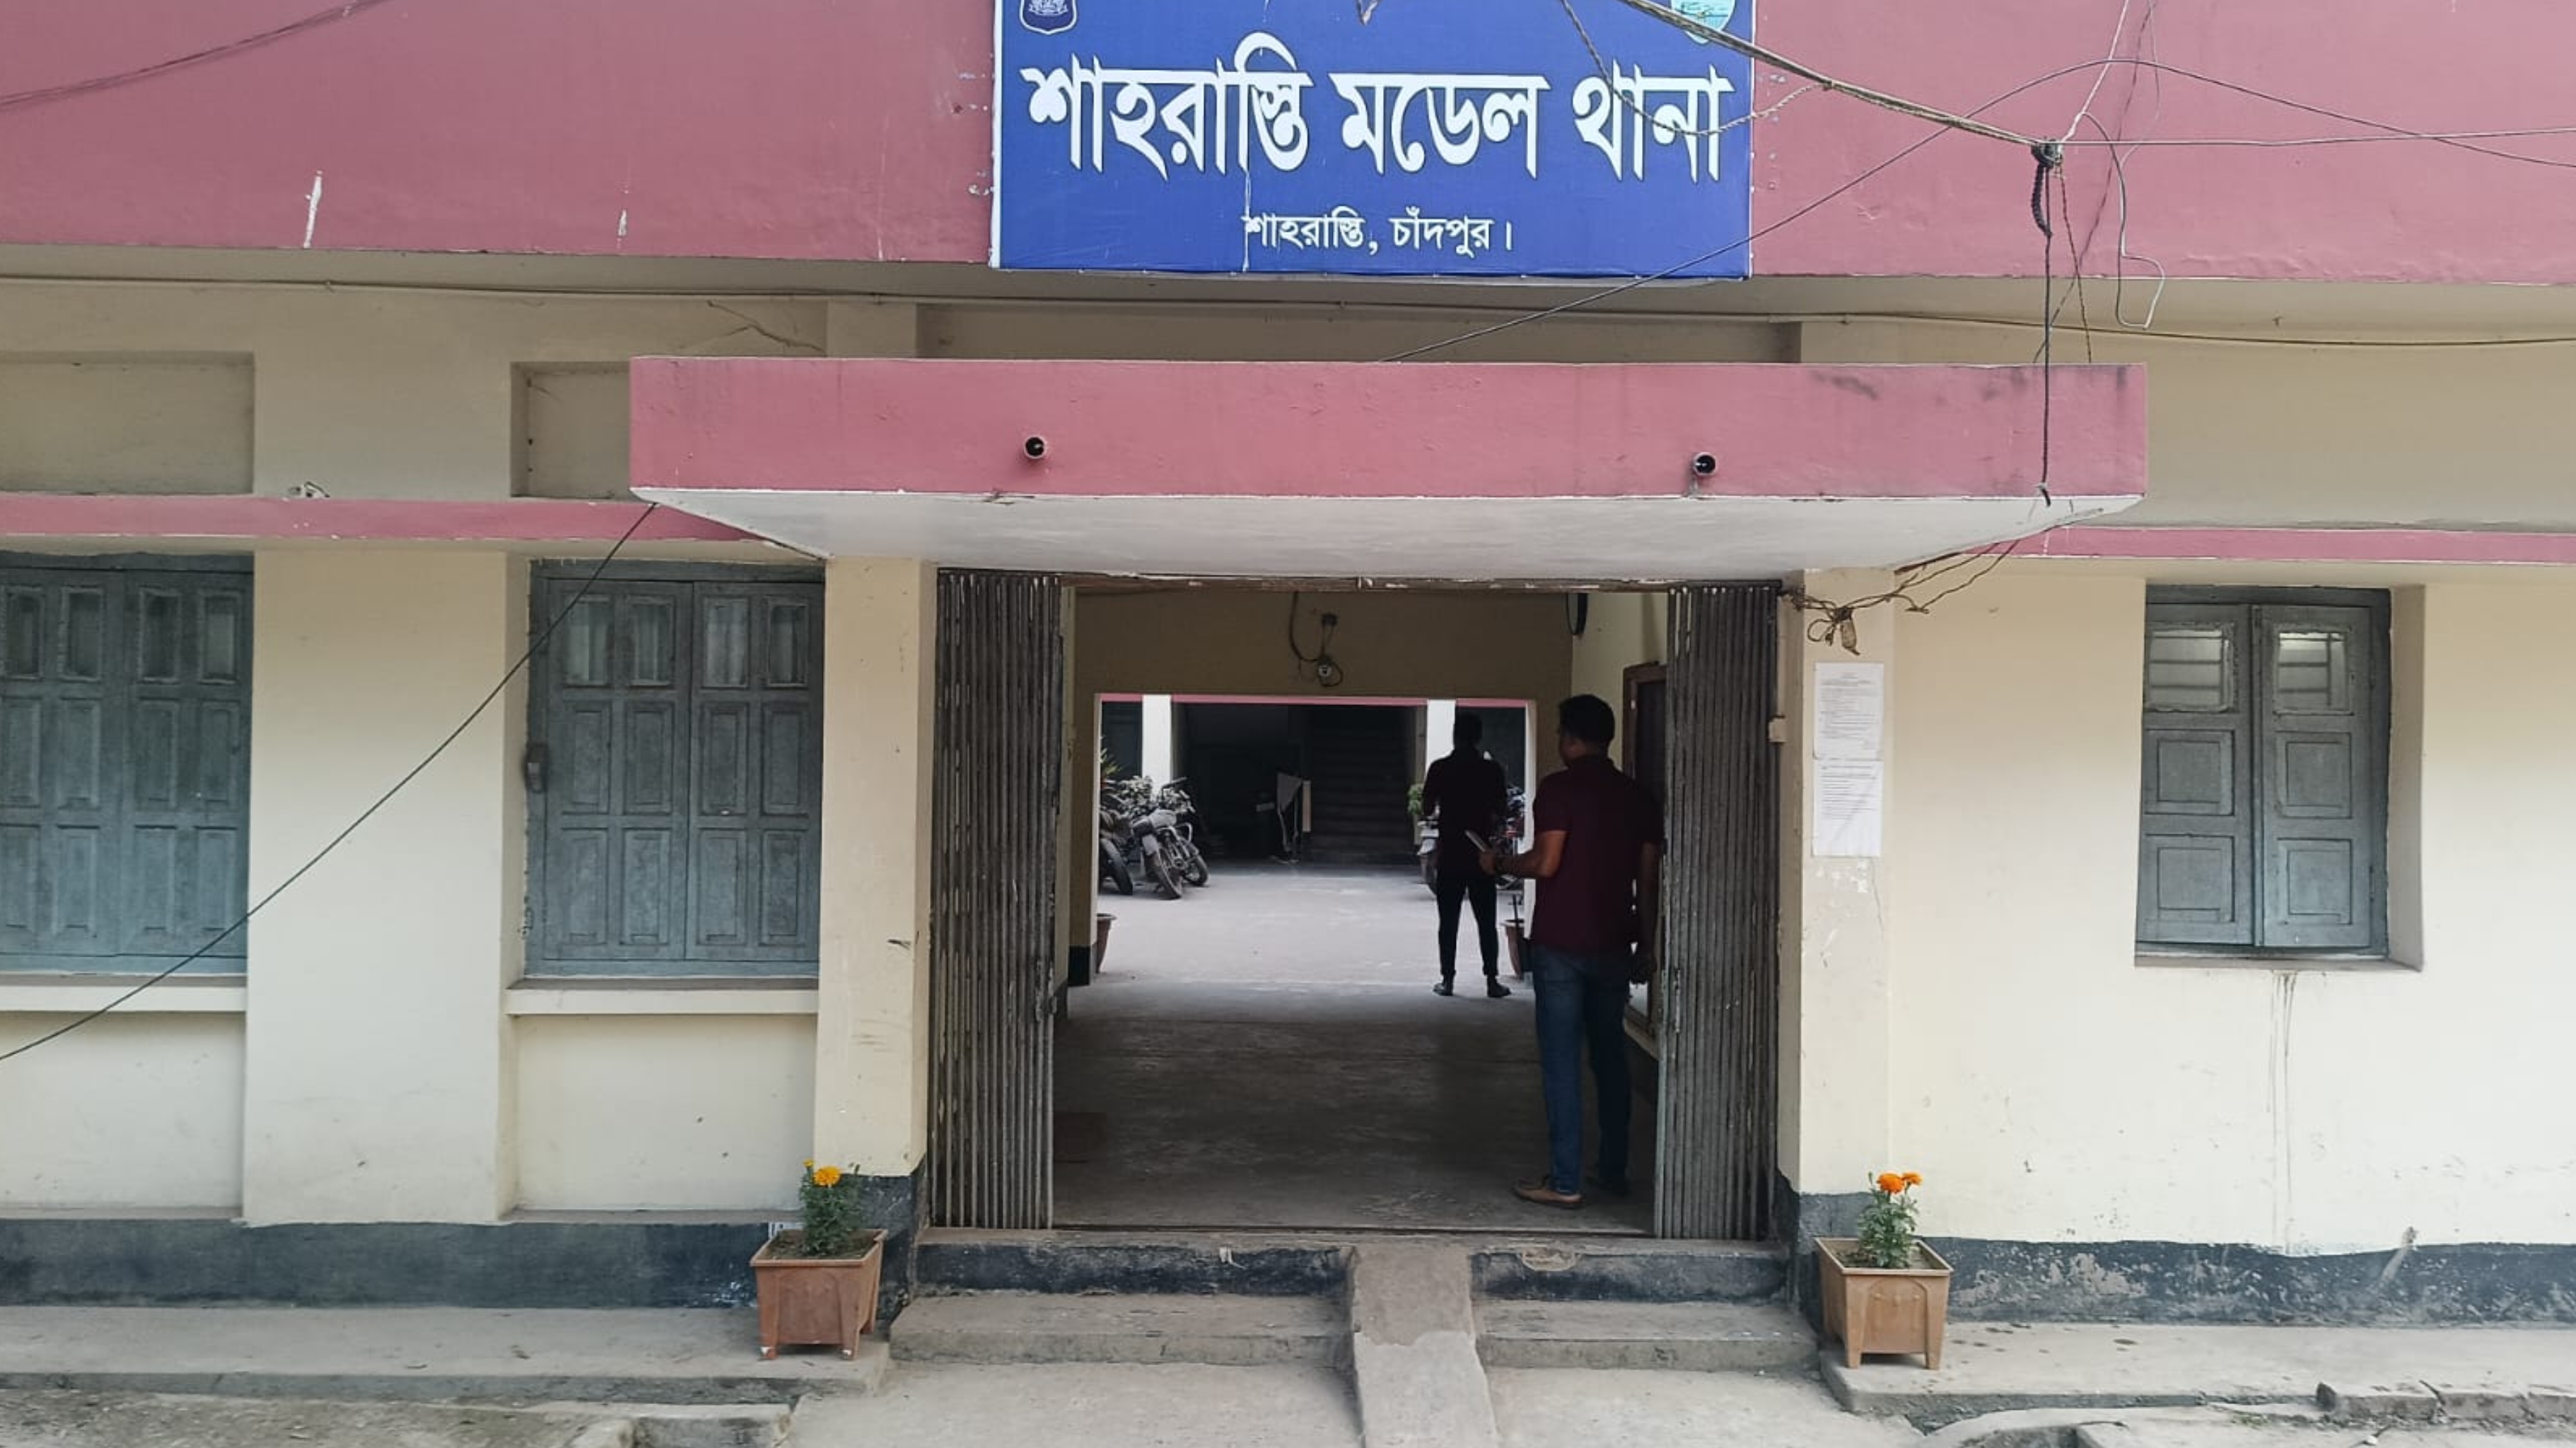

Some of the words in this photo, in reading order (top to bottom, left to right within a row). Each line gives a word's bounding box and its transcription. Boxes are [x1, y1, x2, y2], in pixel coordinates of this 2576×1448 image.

[1020, 32, 1315, 181] শাহরাস্তি
[1329, 73, 1551, 180] মডেল
[1572, 59, 1735, 183] থানা
[1242, 206, 1378, 255] শাহরাস্তি,
